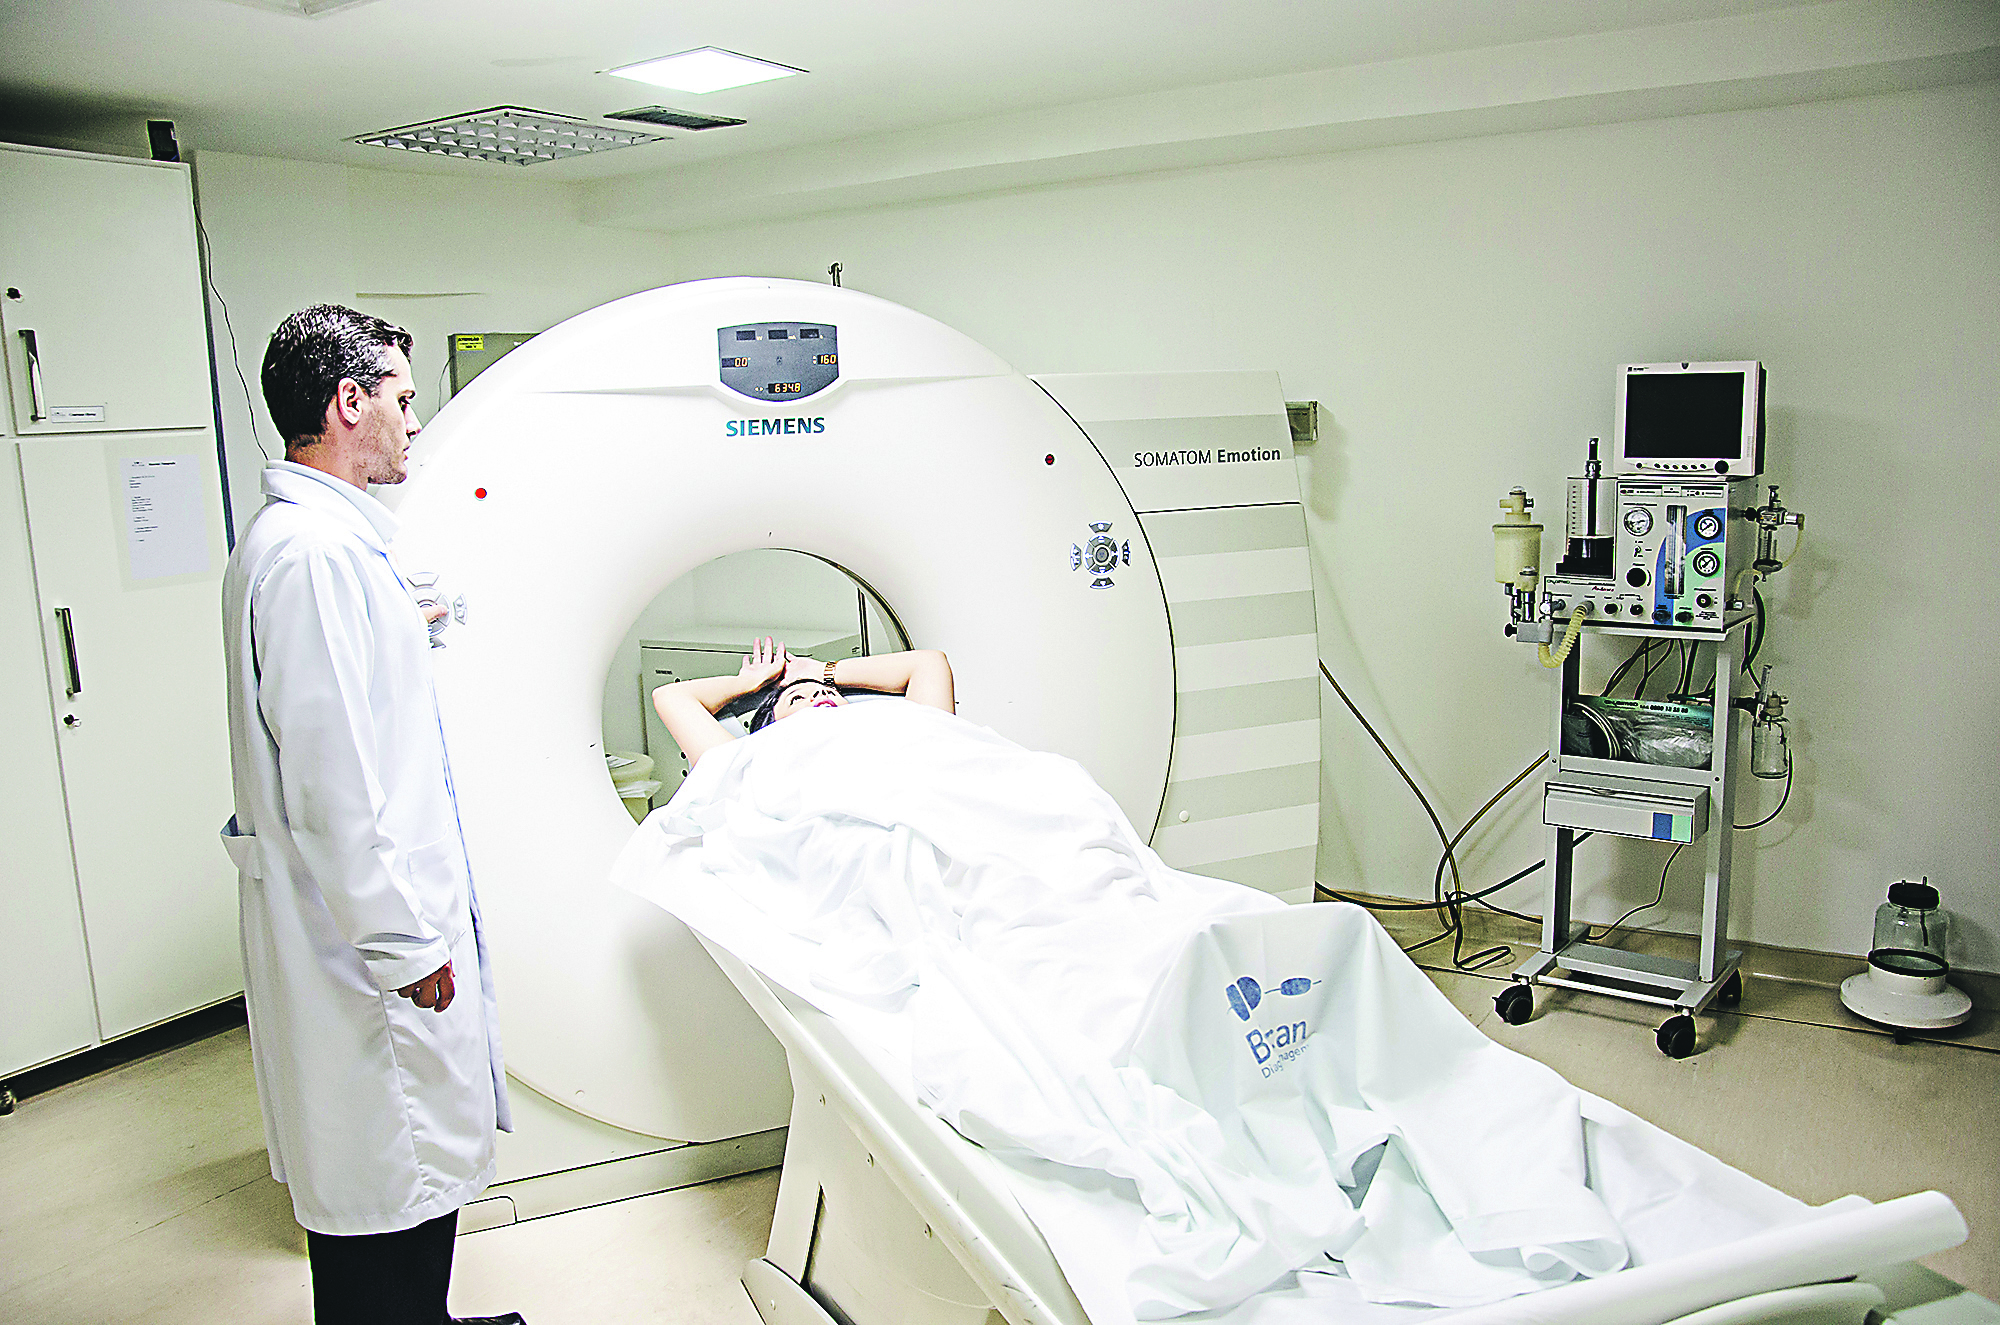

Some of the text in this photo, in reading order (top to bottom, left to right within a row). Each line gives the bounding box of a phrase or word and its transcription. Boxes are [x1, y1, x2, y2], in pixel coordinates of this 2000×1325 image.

[820, 354, 837, 365] 160
[726, 417, 826, 437] SIEMENS
[1134, 446, 1281, 468] SOMATOM Emotion
